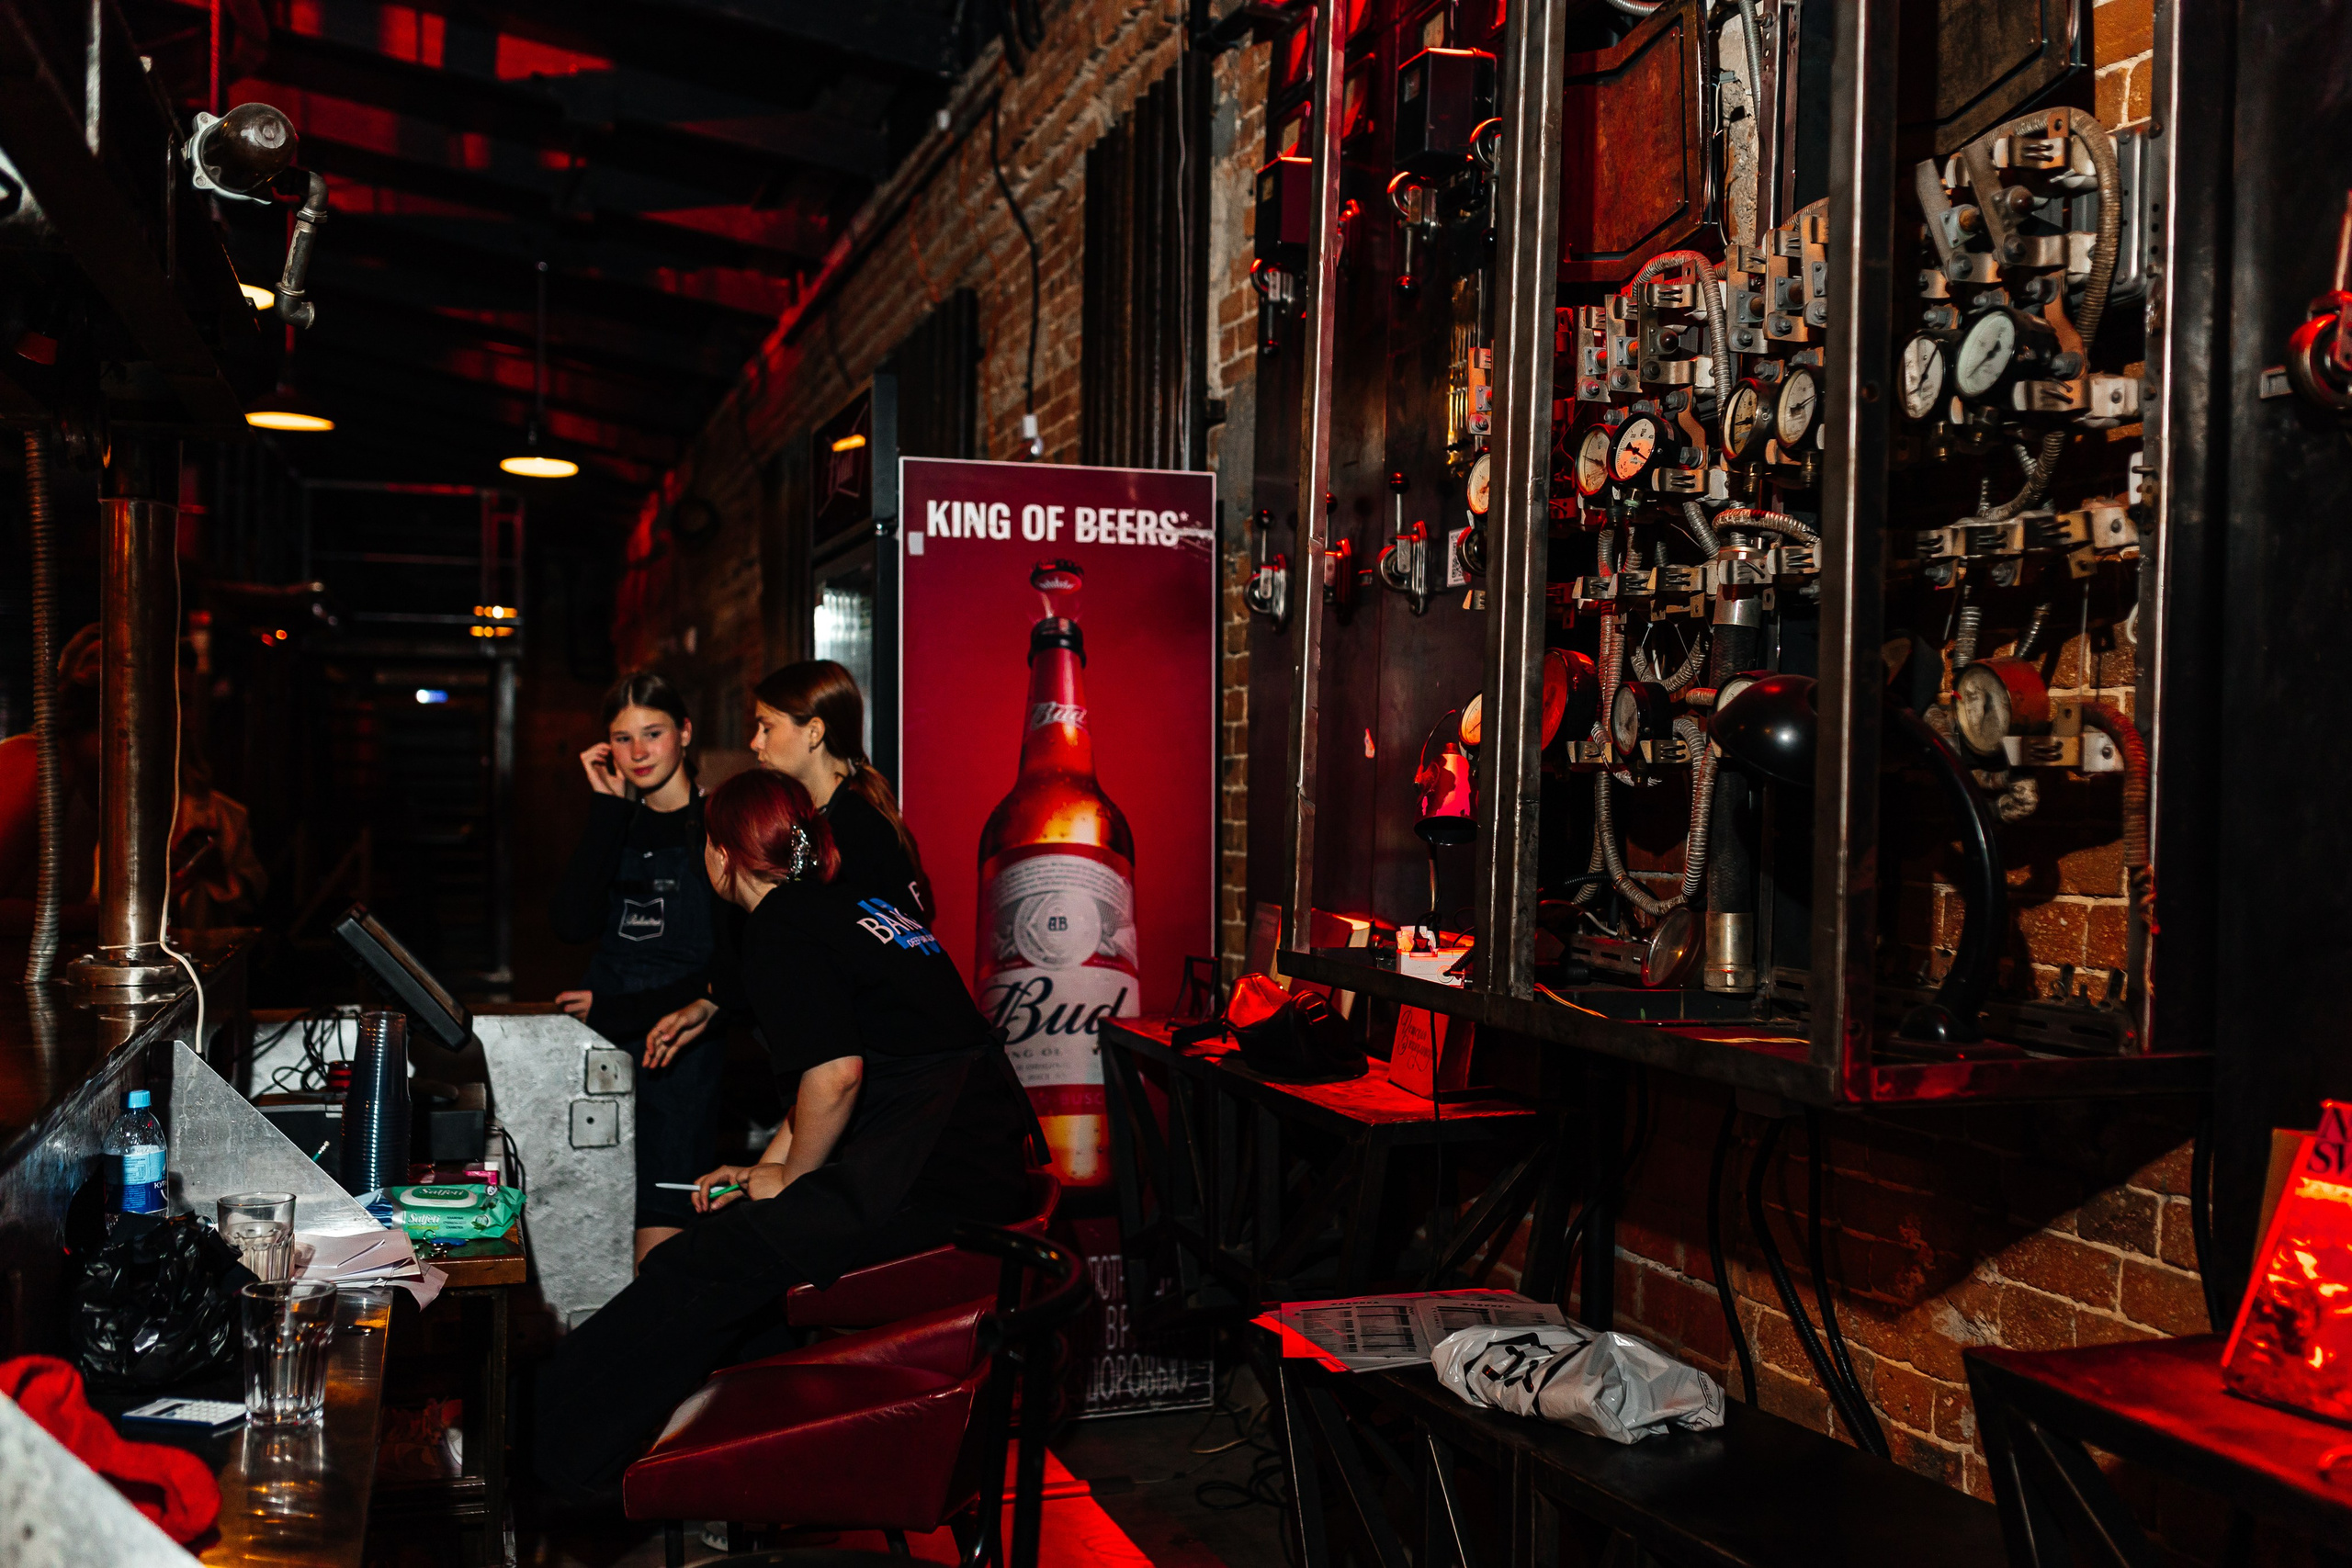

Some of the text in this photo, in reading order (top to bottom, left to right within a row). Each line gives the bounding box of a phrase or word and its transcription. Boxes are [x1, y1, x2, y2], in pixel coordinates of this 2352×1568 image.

[926, 500, 1011, 540] KING
[1022, 504, 1065, 542] OF
[978, 976, 1128, 1046] Bud
[418, 1187, 465, 1196] Salfeti
[407, 1213, 441, 1225] Salfeti
